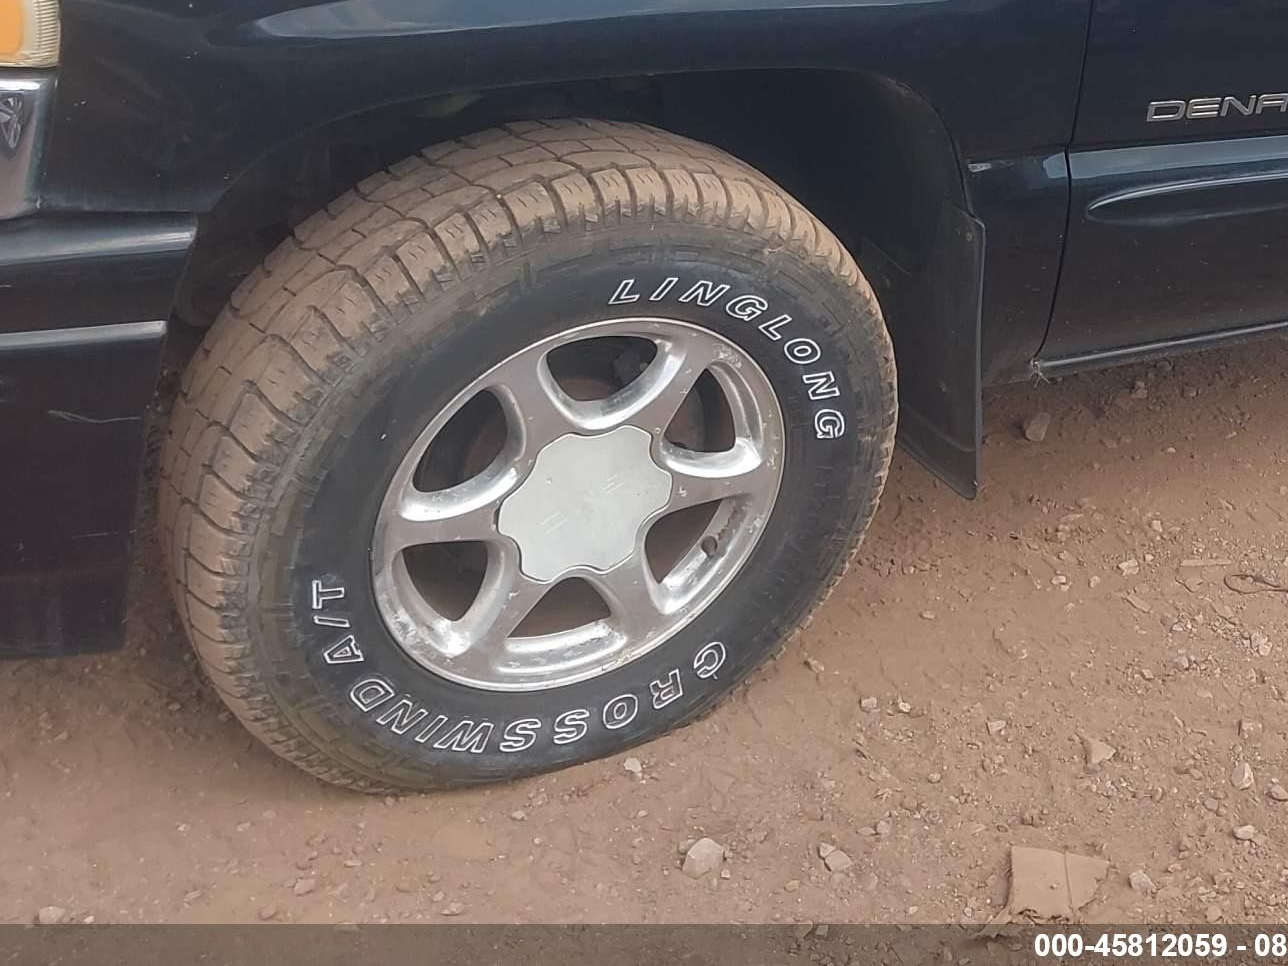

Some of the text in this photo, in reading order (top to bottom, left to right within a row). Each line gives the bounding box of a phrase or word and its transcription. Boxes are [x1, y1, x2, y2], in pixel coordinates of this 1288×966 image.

[607, 277, 846, 440] LINGLONG
[312, 579, 727, 754] CROSSWIND A/T
